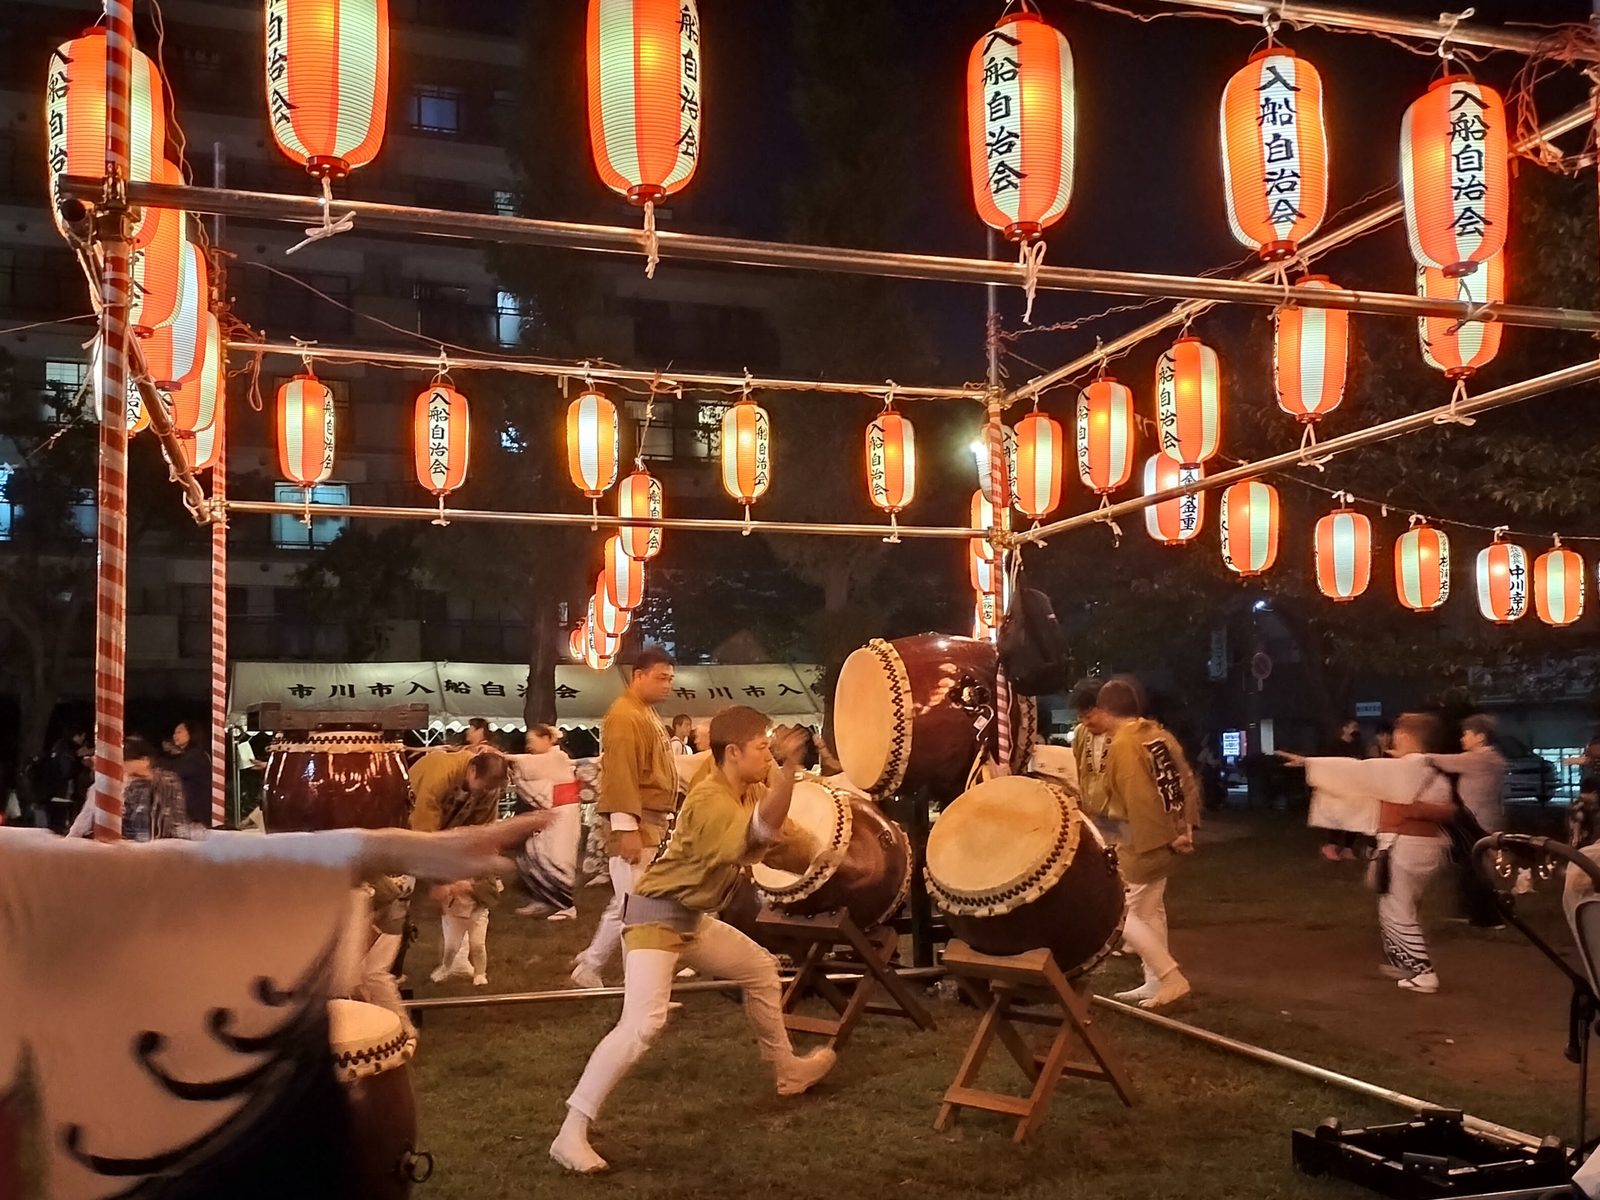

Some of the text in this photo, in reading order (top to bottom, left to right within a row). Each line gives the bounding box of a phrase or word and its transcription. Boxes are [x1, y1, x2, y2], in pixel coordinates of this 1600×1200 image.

[268, 0, 299, 127] 自治会
[982, 30, 1028, 194] 入船自治会
[1254, 65, 1307, 226] 入船自治会
[1445, 89, 1493, 238] 入船自治会
[428, 391, 451, 476] 入船自治会
[755, 411, 769, 487] 入船自治会
[1158, 353, 1181, 449] 入船自治会
[868, 423, 889, 497] 入船自治会
